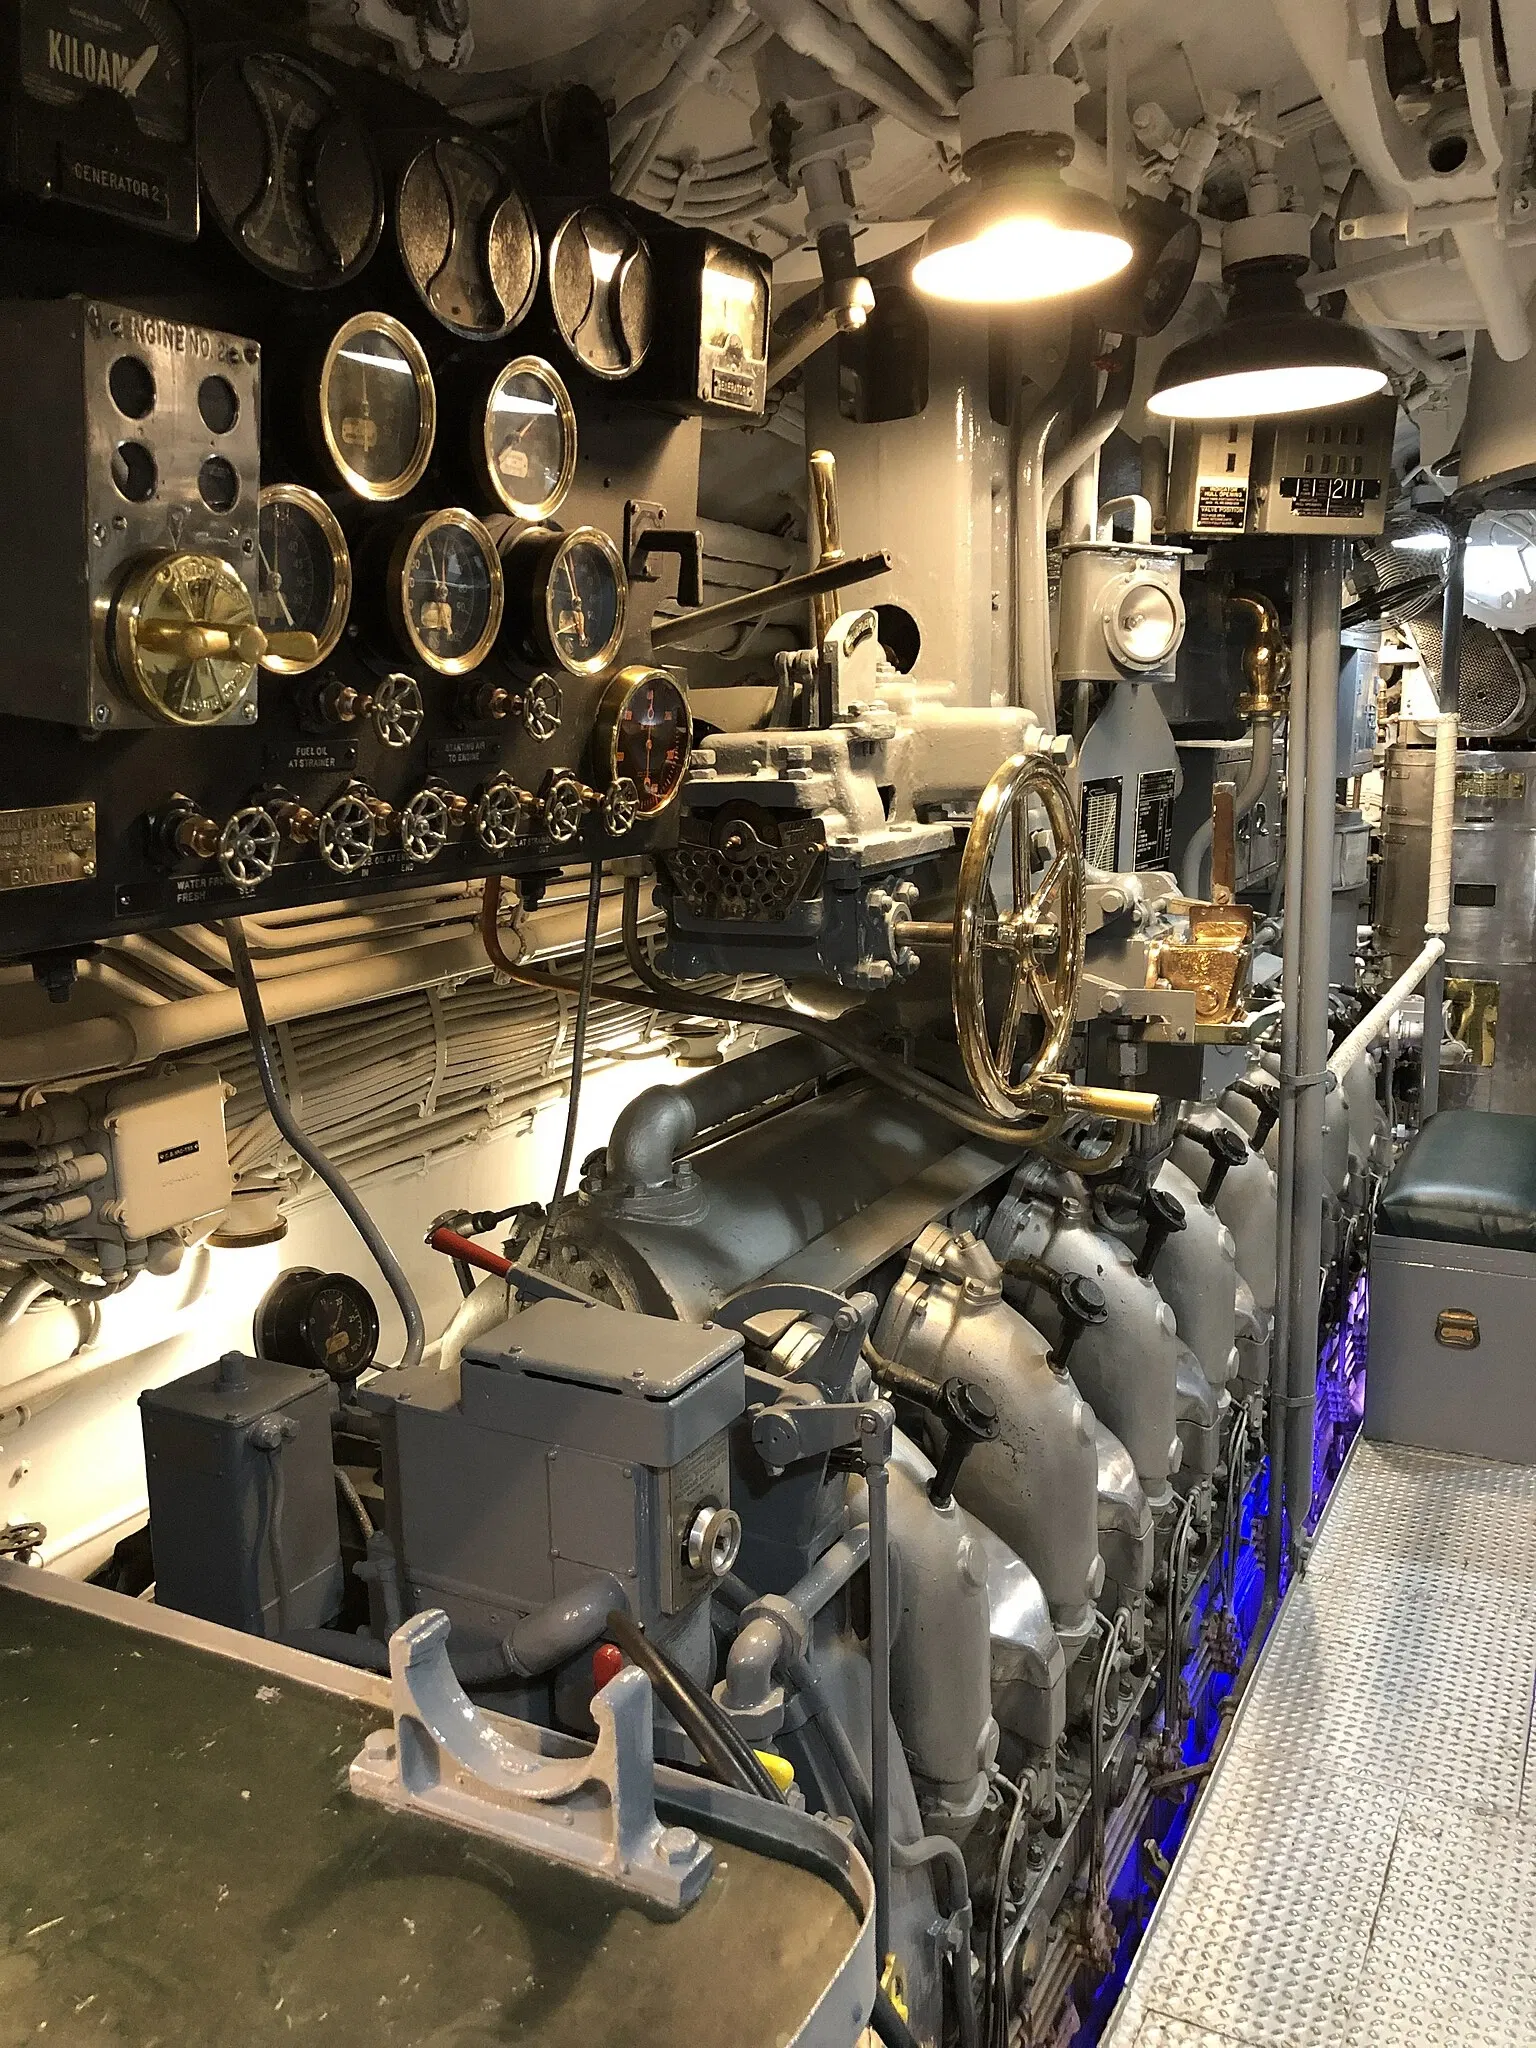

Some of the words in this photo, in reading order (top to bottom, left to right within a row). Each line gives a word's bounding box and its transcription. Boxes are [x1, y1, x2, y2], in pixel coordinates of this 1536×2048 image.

[74, 162, 149, 199] GENERATOR
[152, 186, 160, 201] 2
[296, 747, 315, 756] FUEL
[316, 746, 328, 756] OIL
[300, 757, 336, 768] STRAINER
[448, 754, 456, 763] TO
[11, 863, 72, 885] BOWFIN
[177, 879, 207, 890] WATER
[177, 891, 207, 903] FRESH
